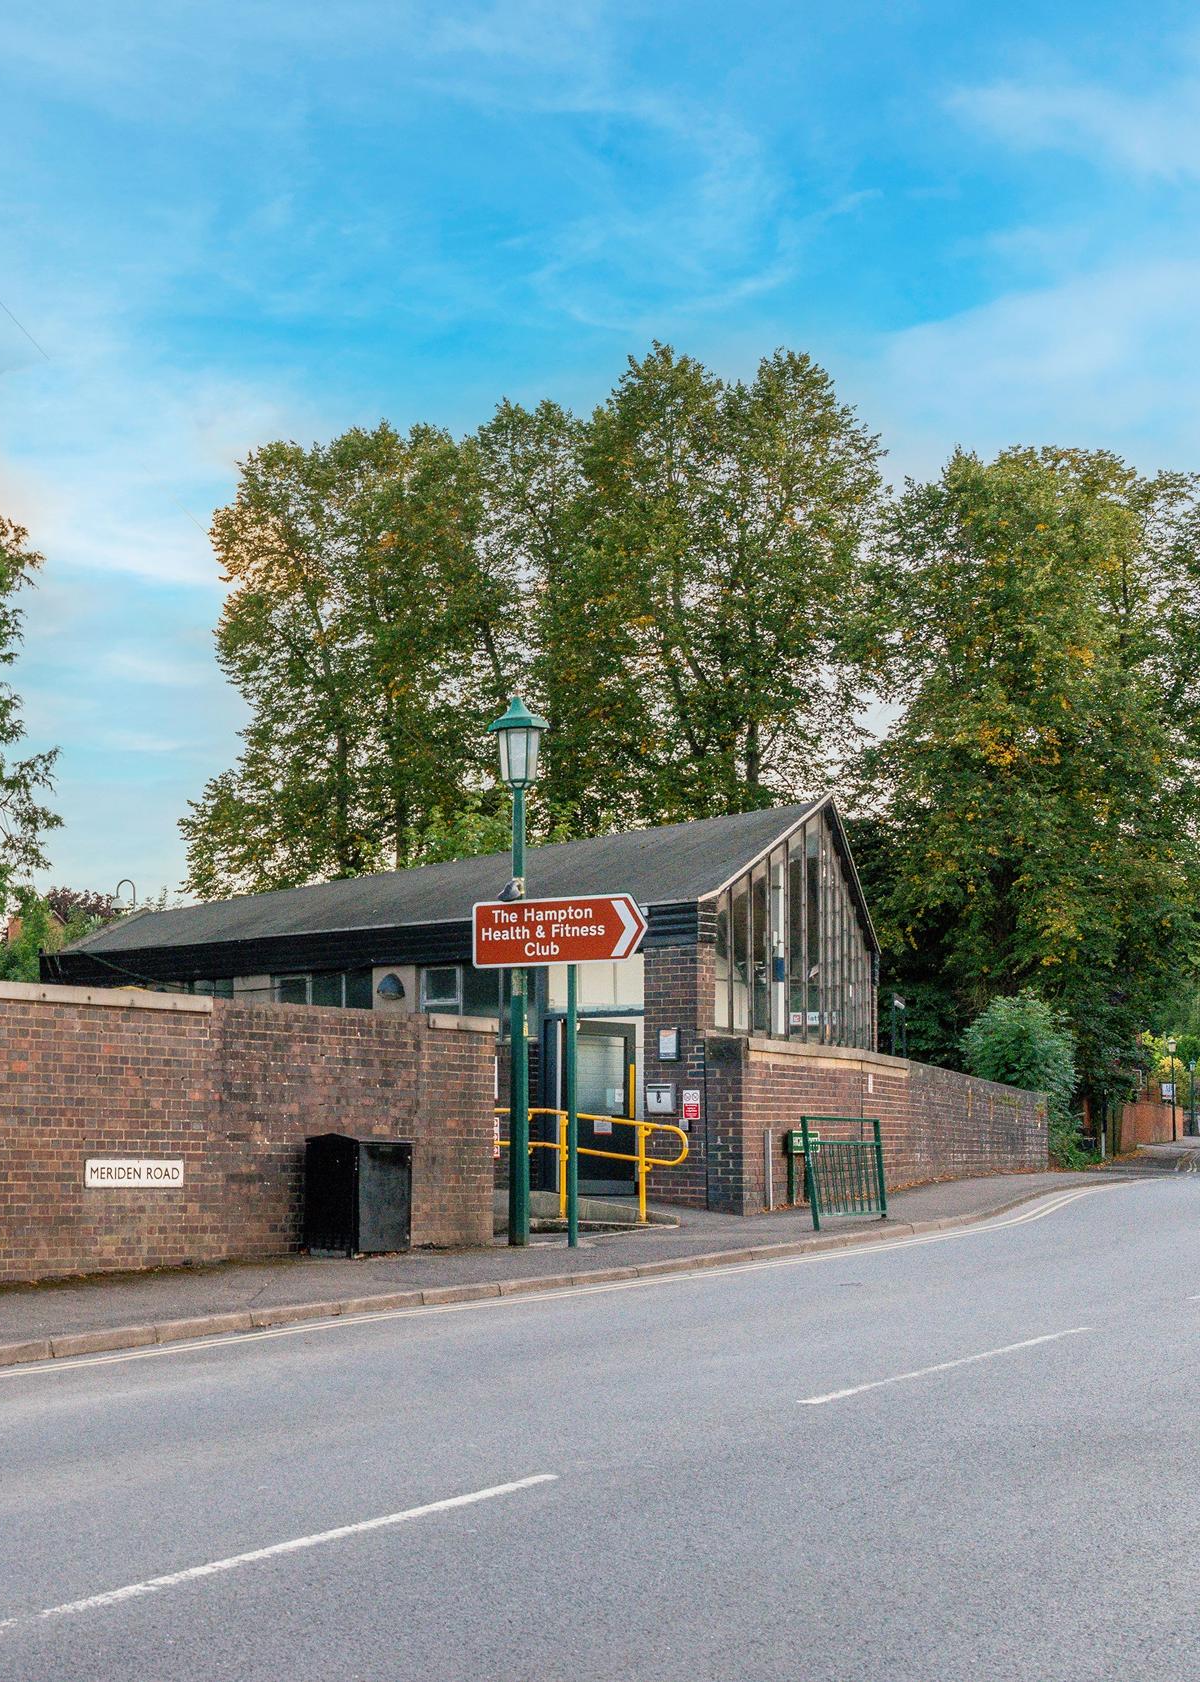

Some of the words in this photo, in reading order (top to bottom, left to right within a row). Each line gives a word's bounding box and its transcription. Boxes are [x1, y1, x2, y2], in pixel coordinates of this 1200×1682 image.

[492, 910, 518, 924] The
[524, 906, 593, 922] Hampton
[481, 927, 530, 941] Health
[535, 925, 546, 939] &
[551, 922, 606, 938] Fitness
[524, 941, 560, 957] Club
[90, 1167, 142, 1180] MERIDEN
[146, 1167, 180, 1180] ROAD
